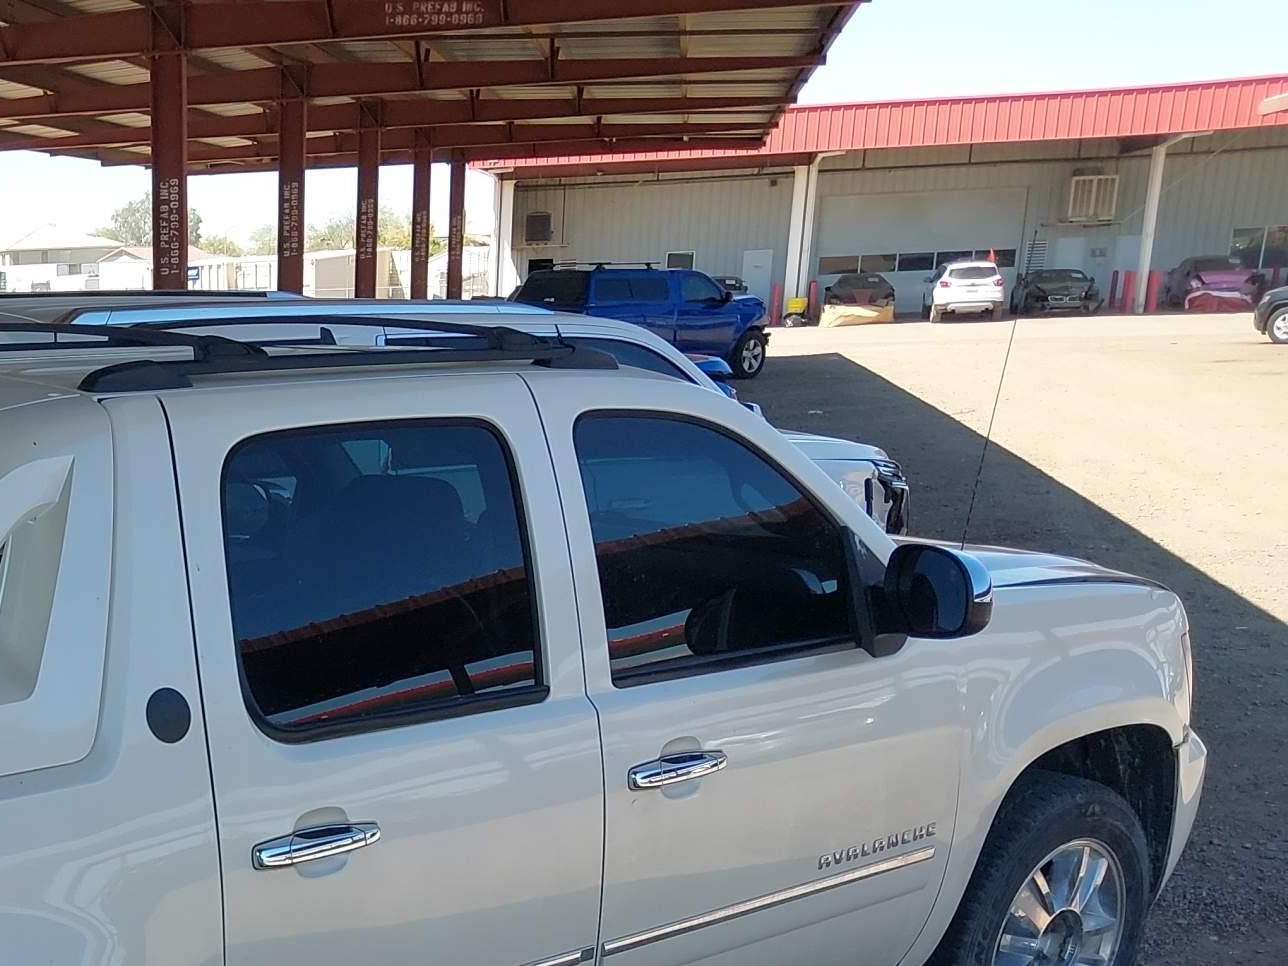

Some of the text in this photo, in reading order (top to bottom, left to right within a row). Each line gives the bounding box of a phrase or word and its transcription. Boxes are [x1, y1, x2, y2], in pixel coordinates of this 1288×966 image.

[412, 1, 457, 13] PREFAB
[462, 0, 485, 13] INC.
[160, 178, 169, 200] INC.
[160, 205, 169, 248] PREFAB
[170, 178, 179, 274] 1-866-799-0969
[817, 821, 937, 870] AVALANCHE
